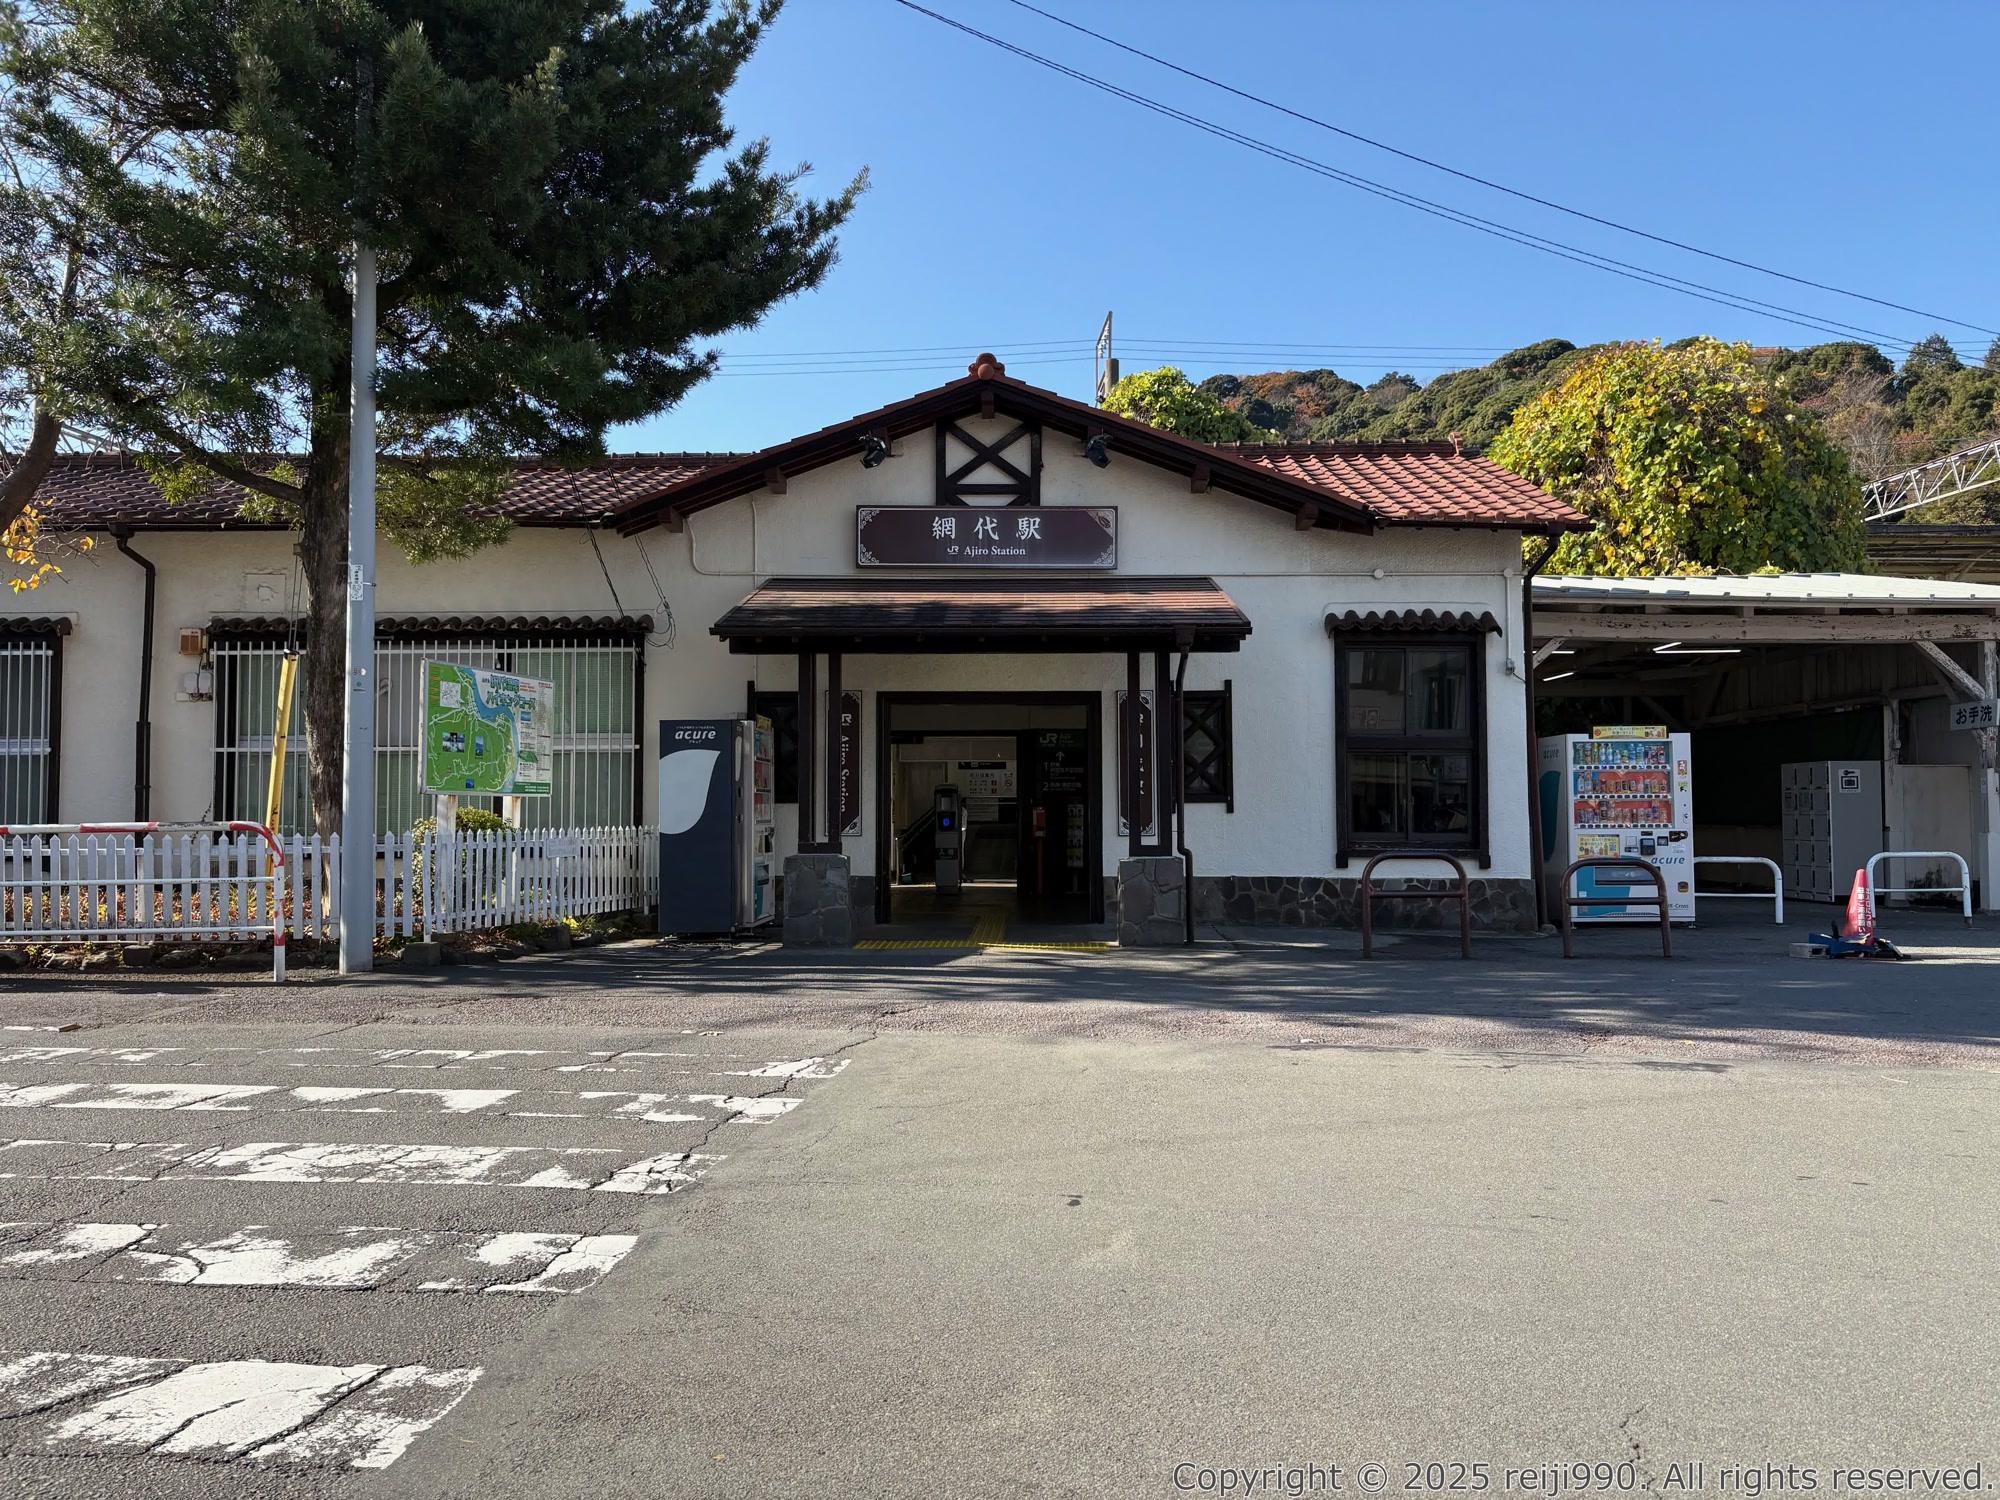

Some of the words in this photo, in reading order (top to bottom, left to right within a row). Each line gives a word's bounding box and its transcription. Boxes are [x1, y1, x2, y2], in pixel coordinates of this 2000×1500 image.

[932, 516, 1042, 540] 網代駅
[947, 546, 960, 554] JR
[964, 546, 989, 557] Ajiro
[991, 546, 1025, 555] Station
[1955, 705, 1993, 725] お手洗
[675, 730, 717, 739] acure
[1039, 733, 1058, 743] JR
[1651, 857, 1685, 865] acure
